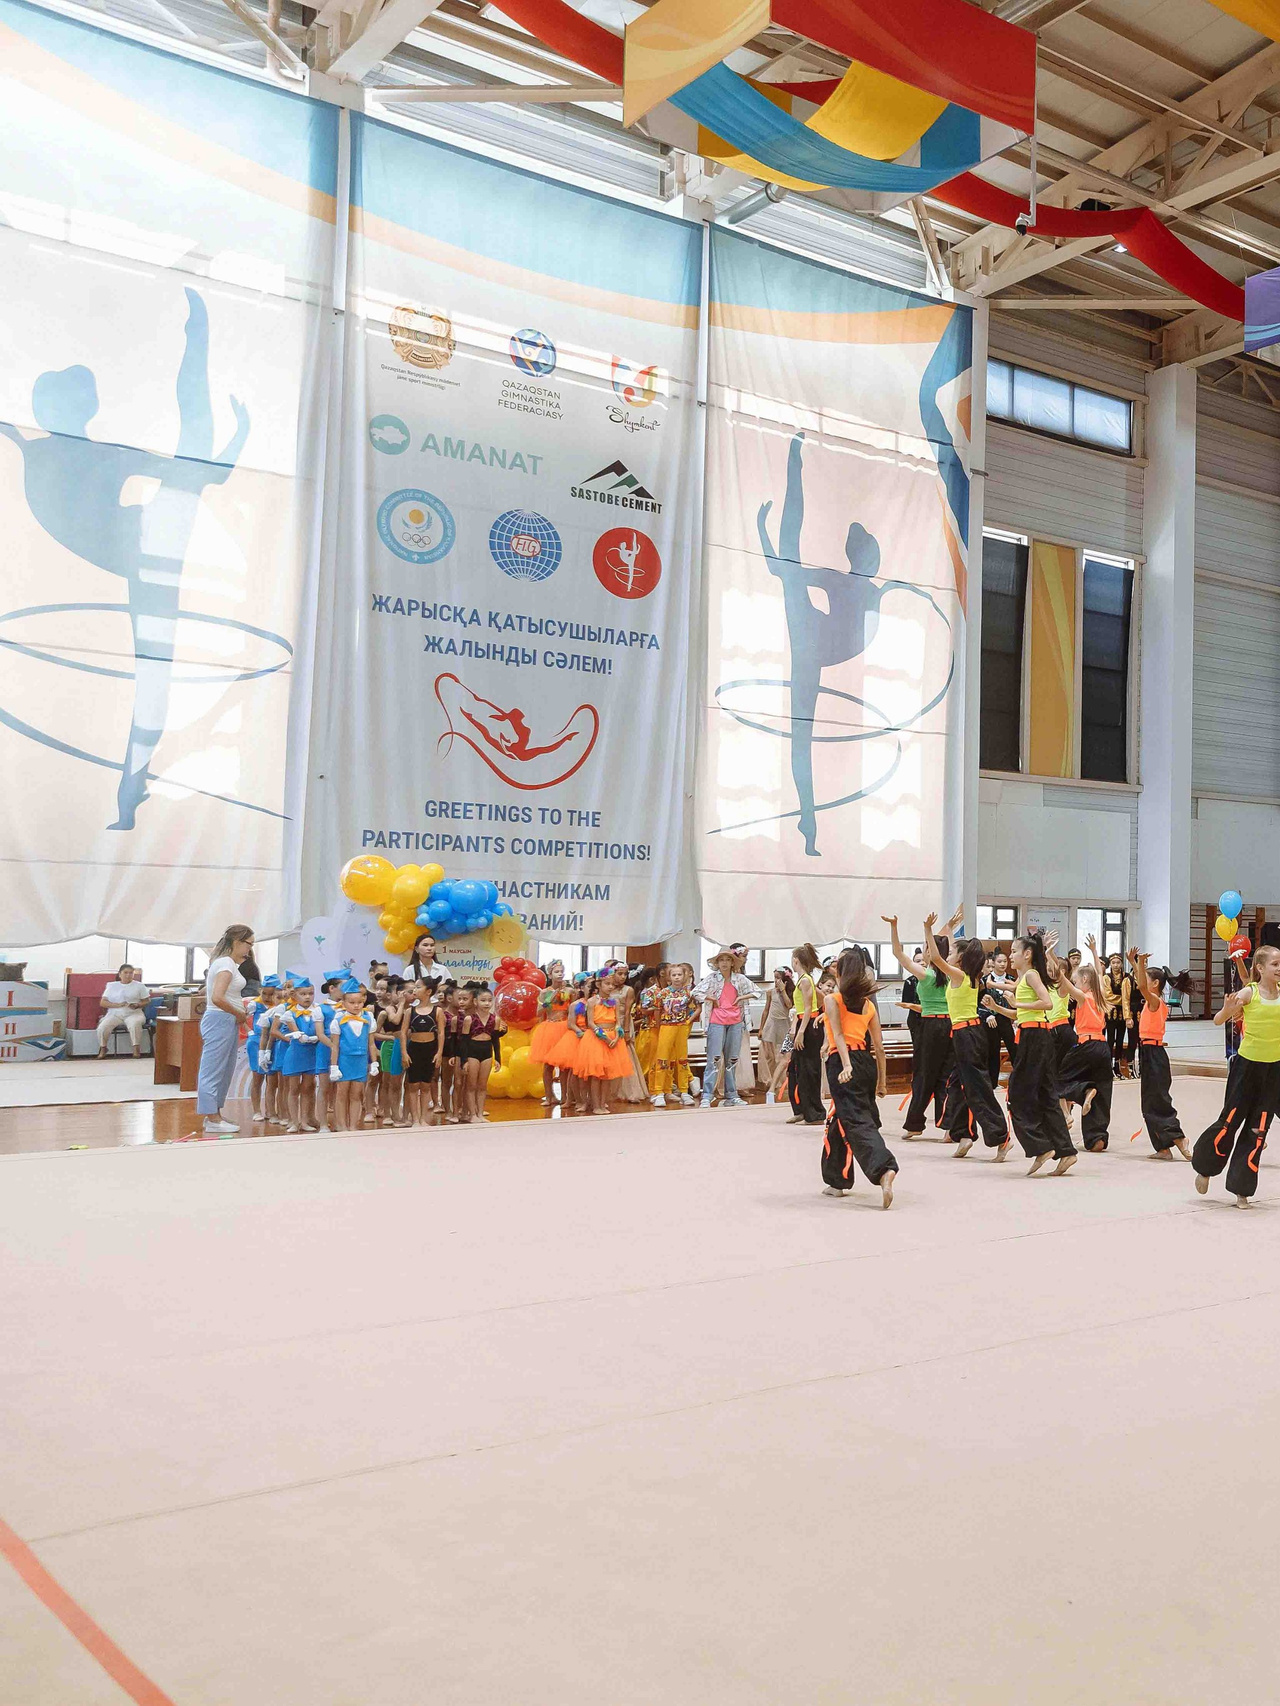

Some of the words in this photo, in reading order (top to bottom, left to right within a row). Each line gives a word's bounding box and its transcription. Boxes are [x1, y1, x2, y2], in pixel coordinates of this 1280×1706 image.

[501, 379, 561, 400] QAZAQSTAN
[501, 389, 562, 411] GIMNASTIKA
[497, 398, 564, 420] FEDERACIASY
[419, 432, 544, 477] AMANAT
[570, 486, 620, 507] SASTOBE
[621, 496, 663, 515] CEMENT
[371, 592, 482, 628] ЖАРЫСҚА
[487, 610, 661, 651] ҚАТЫСУШЫЛАРҒА
[423, 634, 538, 668] ЖАЛЫНДЫ
[543, 649, 613, 675] СӘЛЕМ!
[423, 799, 533, 824] GREETINGS
[538, 807, 563, 825] TO
[567, 808, 602, 828] THE
[361, 829, 506, 854] PARTICIPANTS
[510, 836, 652, 861] COMPETITIONS!
[489, 880, 610, 901] ЧАСТНИКАМ
